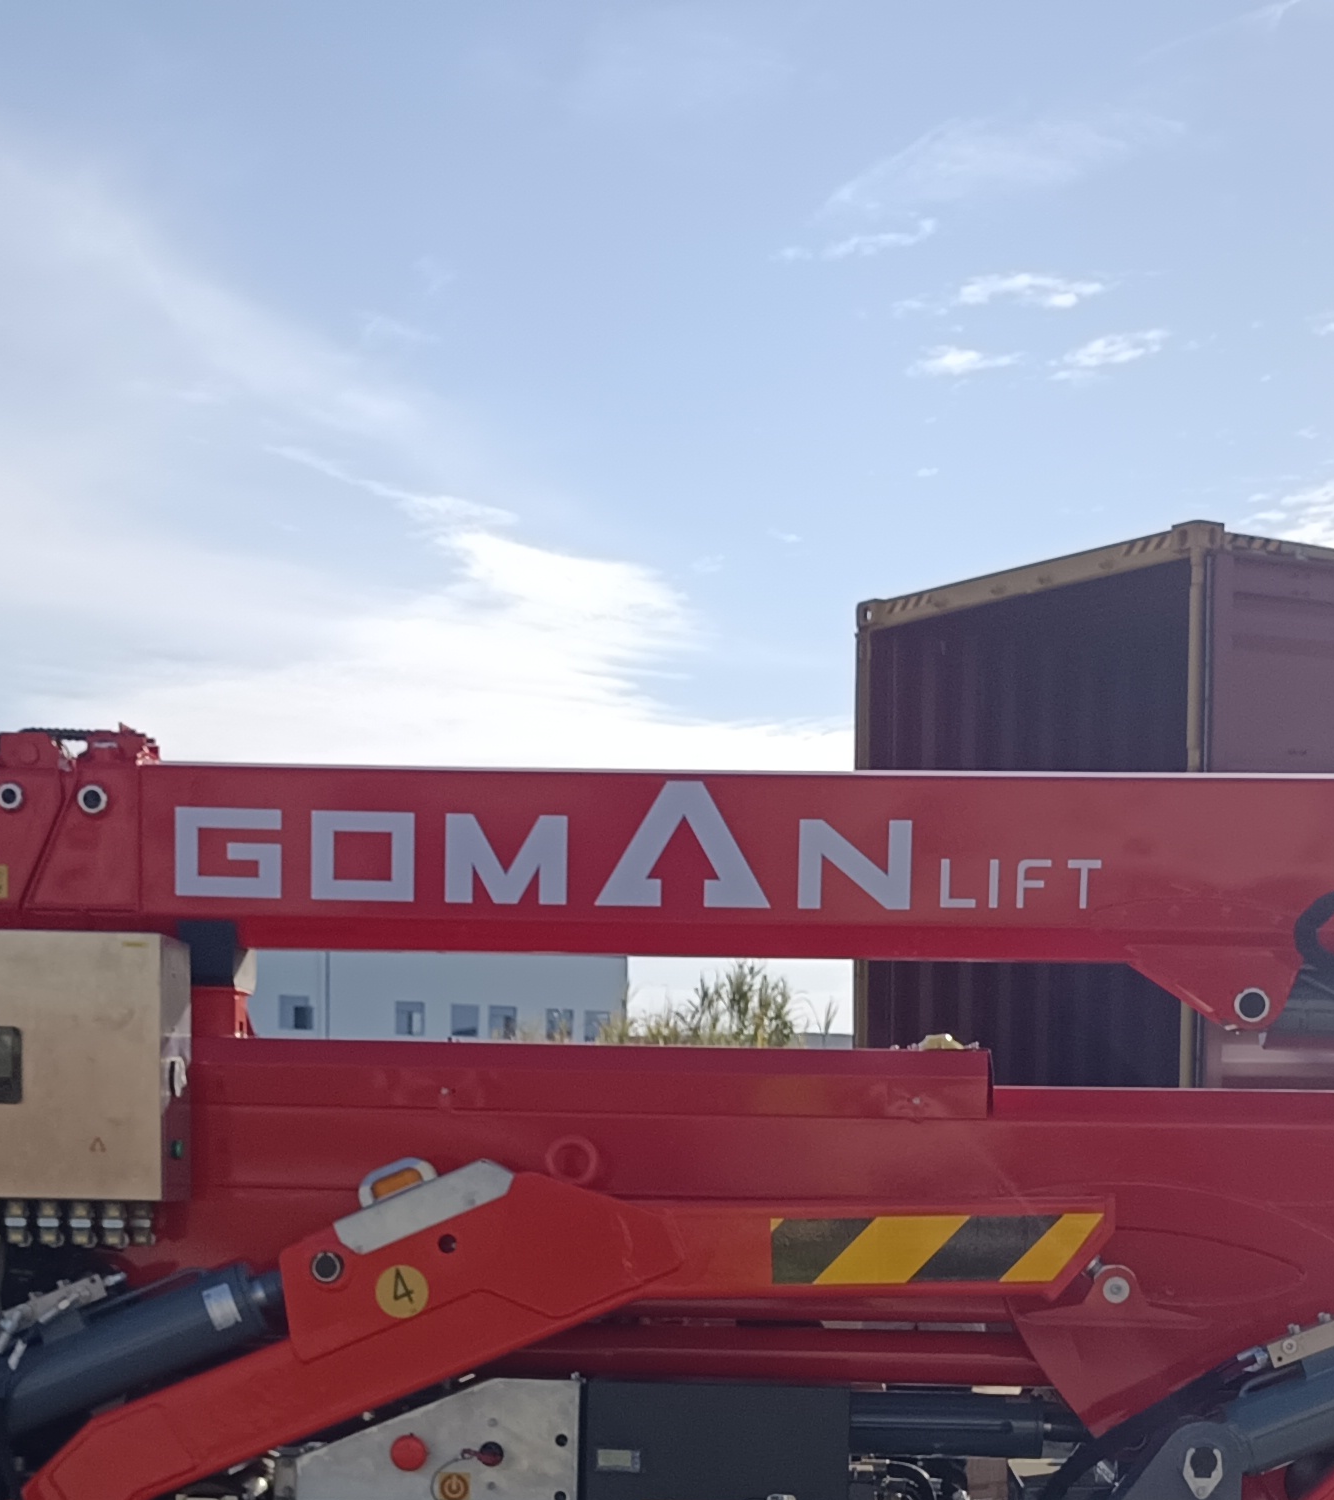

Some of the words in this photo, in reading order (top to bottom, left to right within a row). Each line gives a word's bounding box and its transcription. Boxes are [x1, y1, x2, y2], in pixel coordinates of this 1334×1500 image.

[174, 780, 913, 911] GOMAN
[940, 858, 1103, 909] LIFT
[392, 1267, 415, 1304] 4
